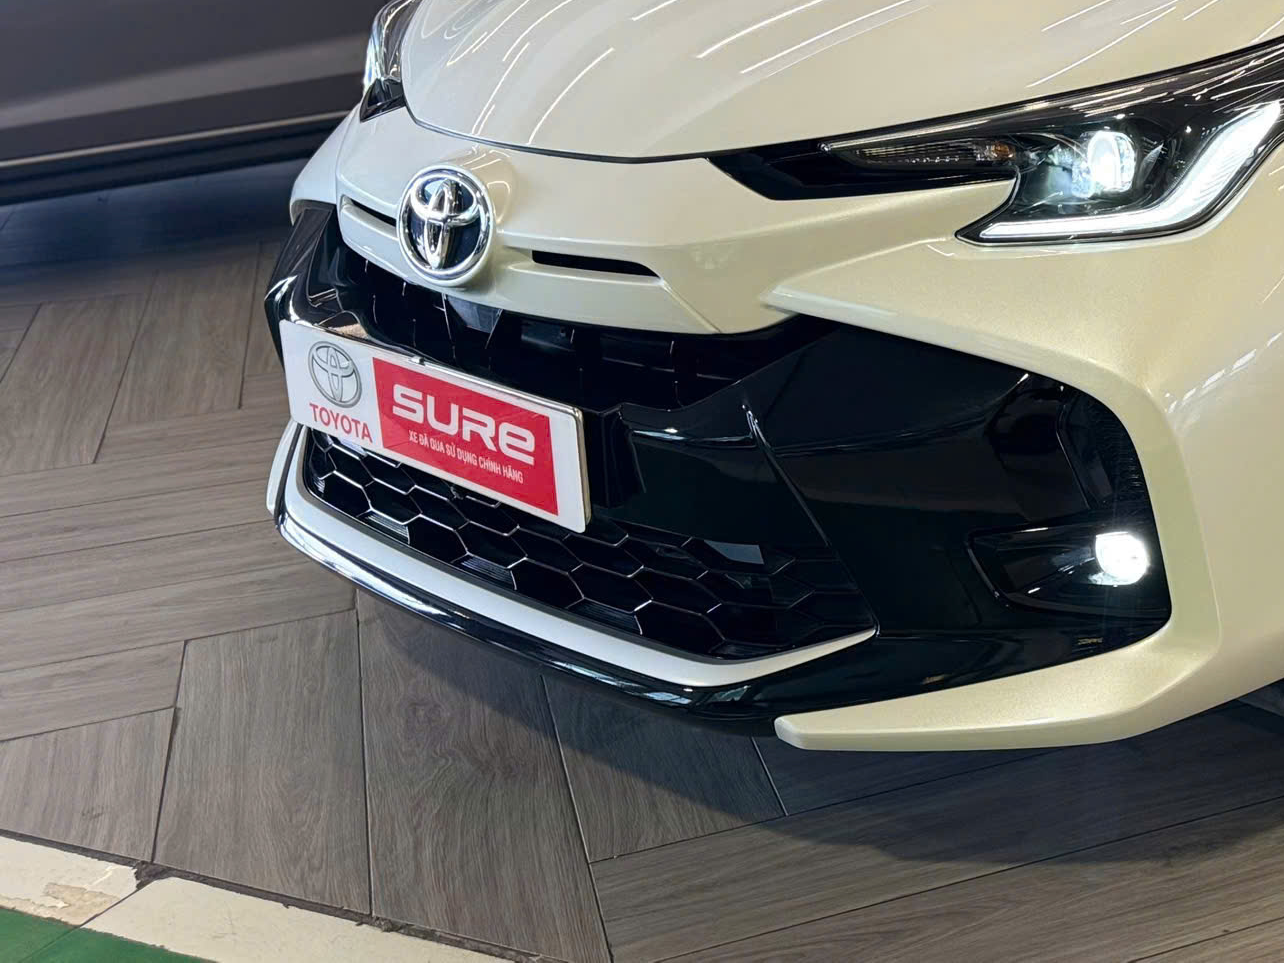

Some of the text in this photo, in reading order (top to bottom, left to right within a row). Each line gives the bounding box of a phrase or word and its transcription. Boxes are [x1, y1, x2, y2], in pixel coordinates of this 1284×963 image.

[309, 403, 373, 444] TOYOTA
[392, 383, 536, 466] SURE
[408, 430, 419, 444] XE
[429, 437, 446, 454] QUA
